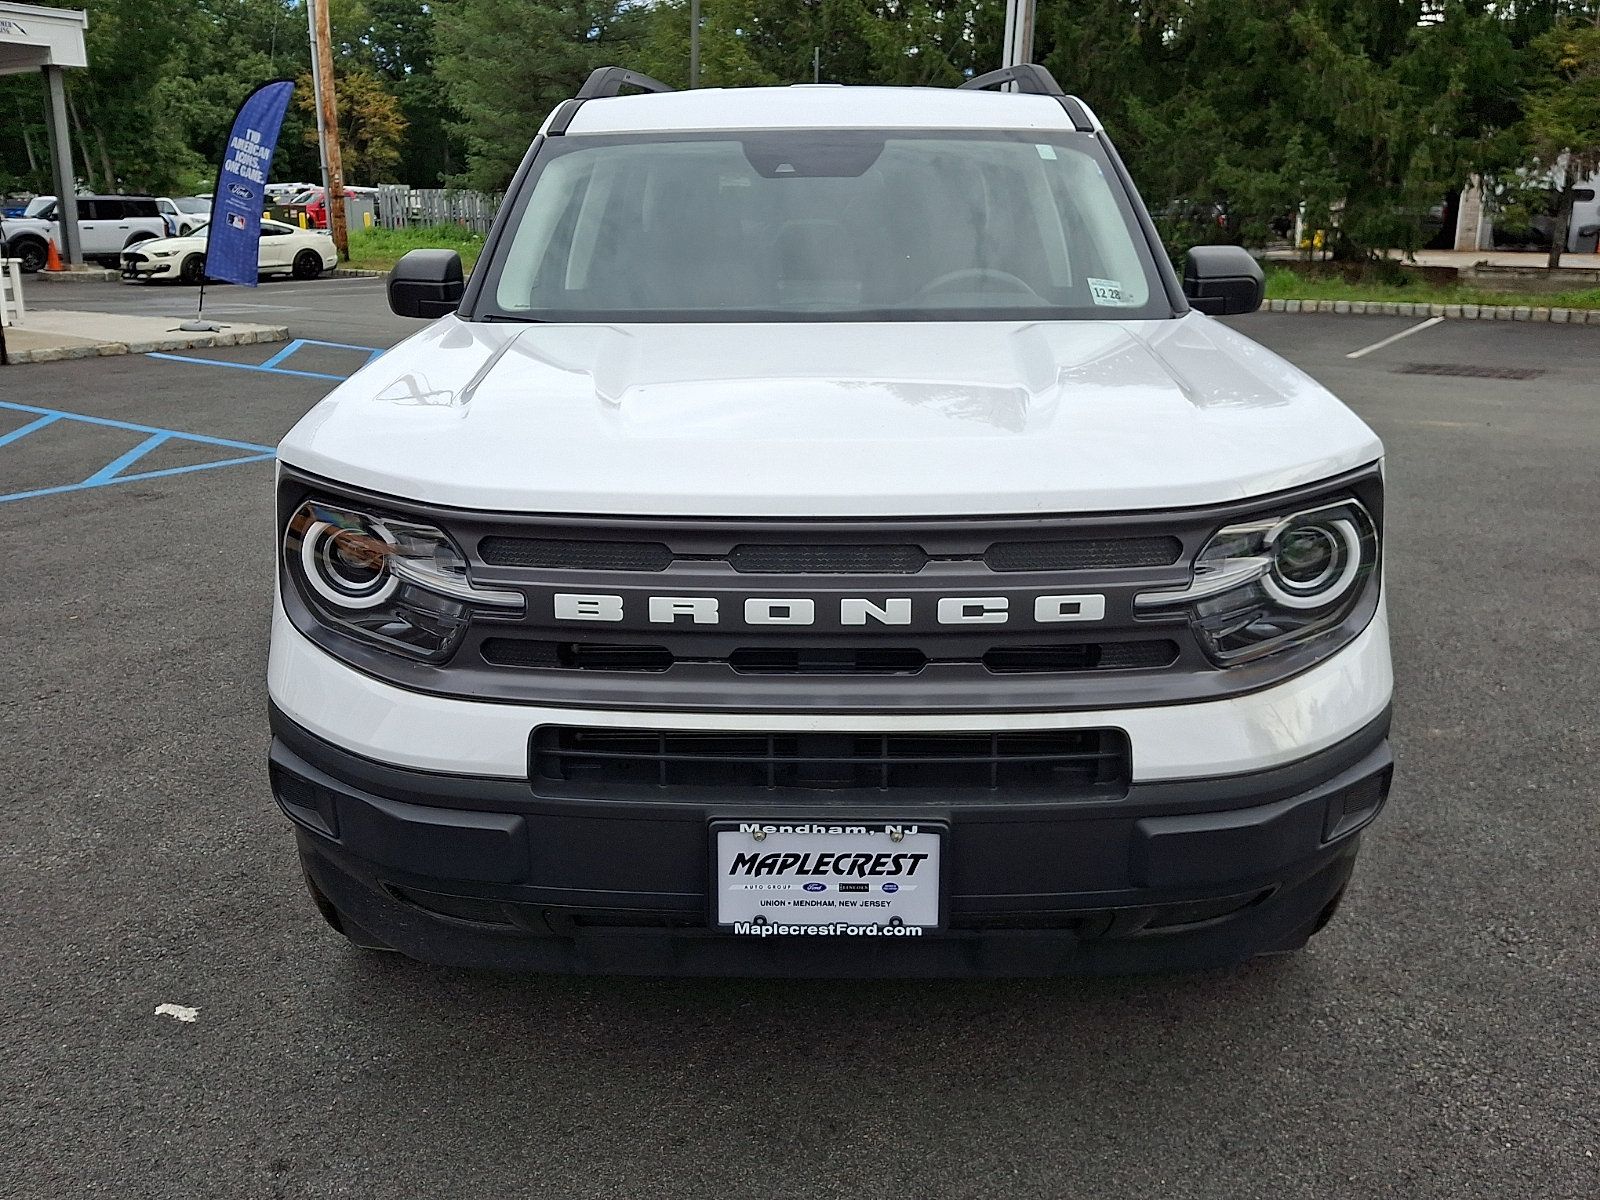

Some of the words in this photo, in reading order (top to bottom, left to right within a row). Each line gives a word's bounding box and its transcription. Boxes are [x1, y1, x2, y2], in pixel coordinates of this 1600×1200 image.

[231, 136, 271, 160] AMERICAN
[225, 159, 241, 175] ONE
[1094, 287, 1108, 299] 12
[1108, 288, 1121, 300] 28
[553, 594, 1106, 624] BRONCO
[740, 823, 875, 836] Mendham,
[885, 825, 918, 835] NJ
[728, 852, 929, 878] MAPLECREST
[806, 883, 823, 891] Ford
[792, 900, 837, 908] MENDHAM,
[859, 900, 892, 908] JERSEY
[734, 922, 923, 937] MaplecrestFord.com
